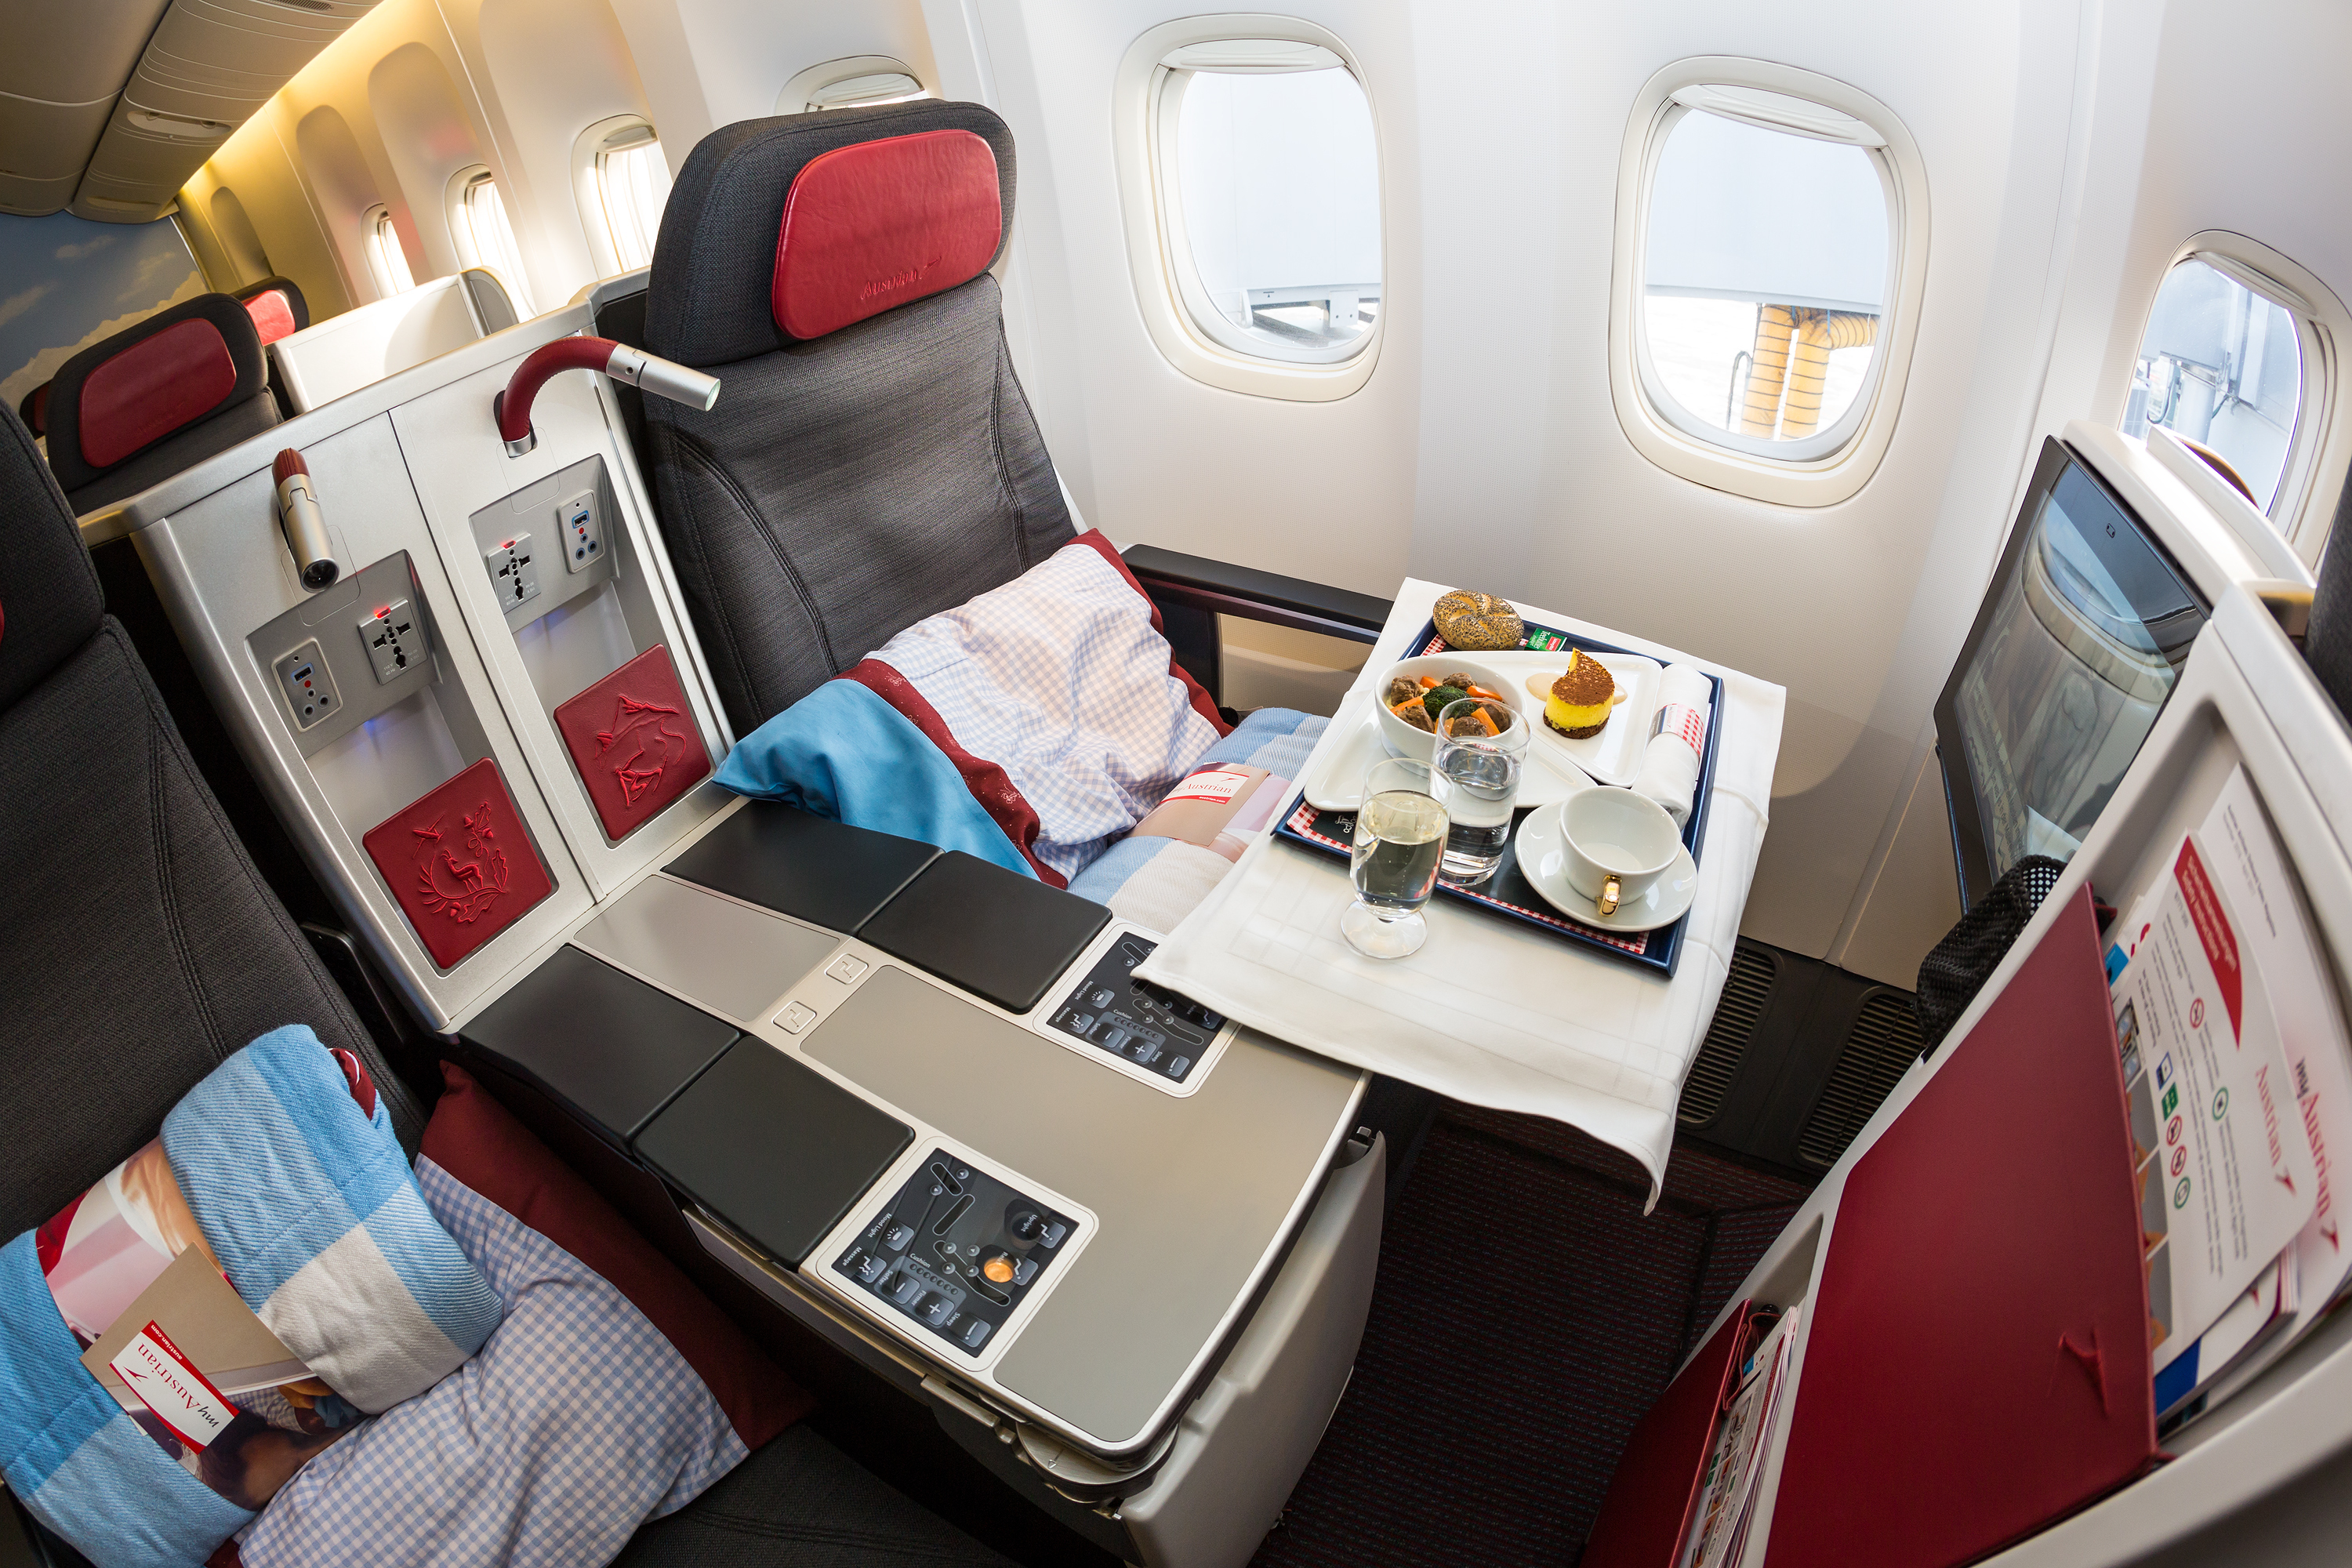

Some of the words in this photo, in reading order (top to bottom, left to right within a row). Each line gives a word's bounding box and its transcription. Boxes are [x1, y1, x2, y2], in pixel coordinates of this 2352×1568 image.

[860, 268, 918, 300] Austrian
[1055, 1007, 1072, 1022] Massage
[1113, 1009, 1133, 1020] Cushion
[1089, 1022, 1101, 1035] Softer
[1120, 1036, 1131, 1049] Firmer
[1152, 1051, 1163, 1062] Sleep
[2256, 1063, 2281, 1168] Austrian
[1021, 1214, 1038, 1232] Upright
[842, 1246, 862, 1266] Massage
[909, 1253, 931, 1269] Cushion
[879, 1269, 894, 1285] Softer
[911, 1290, 927, 1306] Firmer
[946, 1312, 961, 1327] Sleep
[151, 1324, 183, 1360] austrian.com
